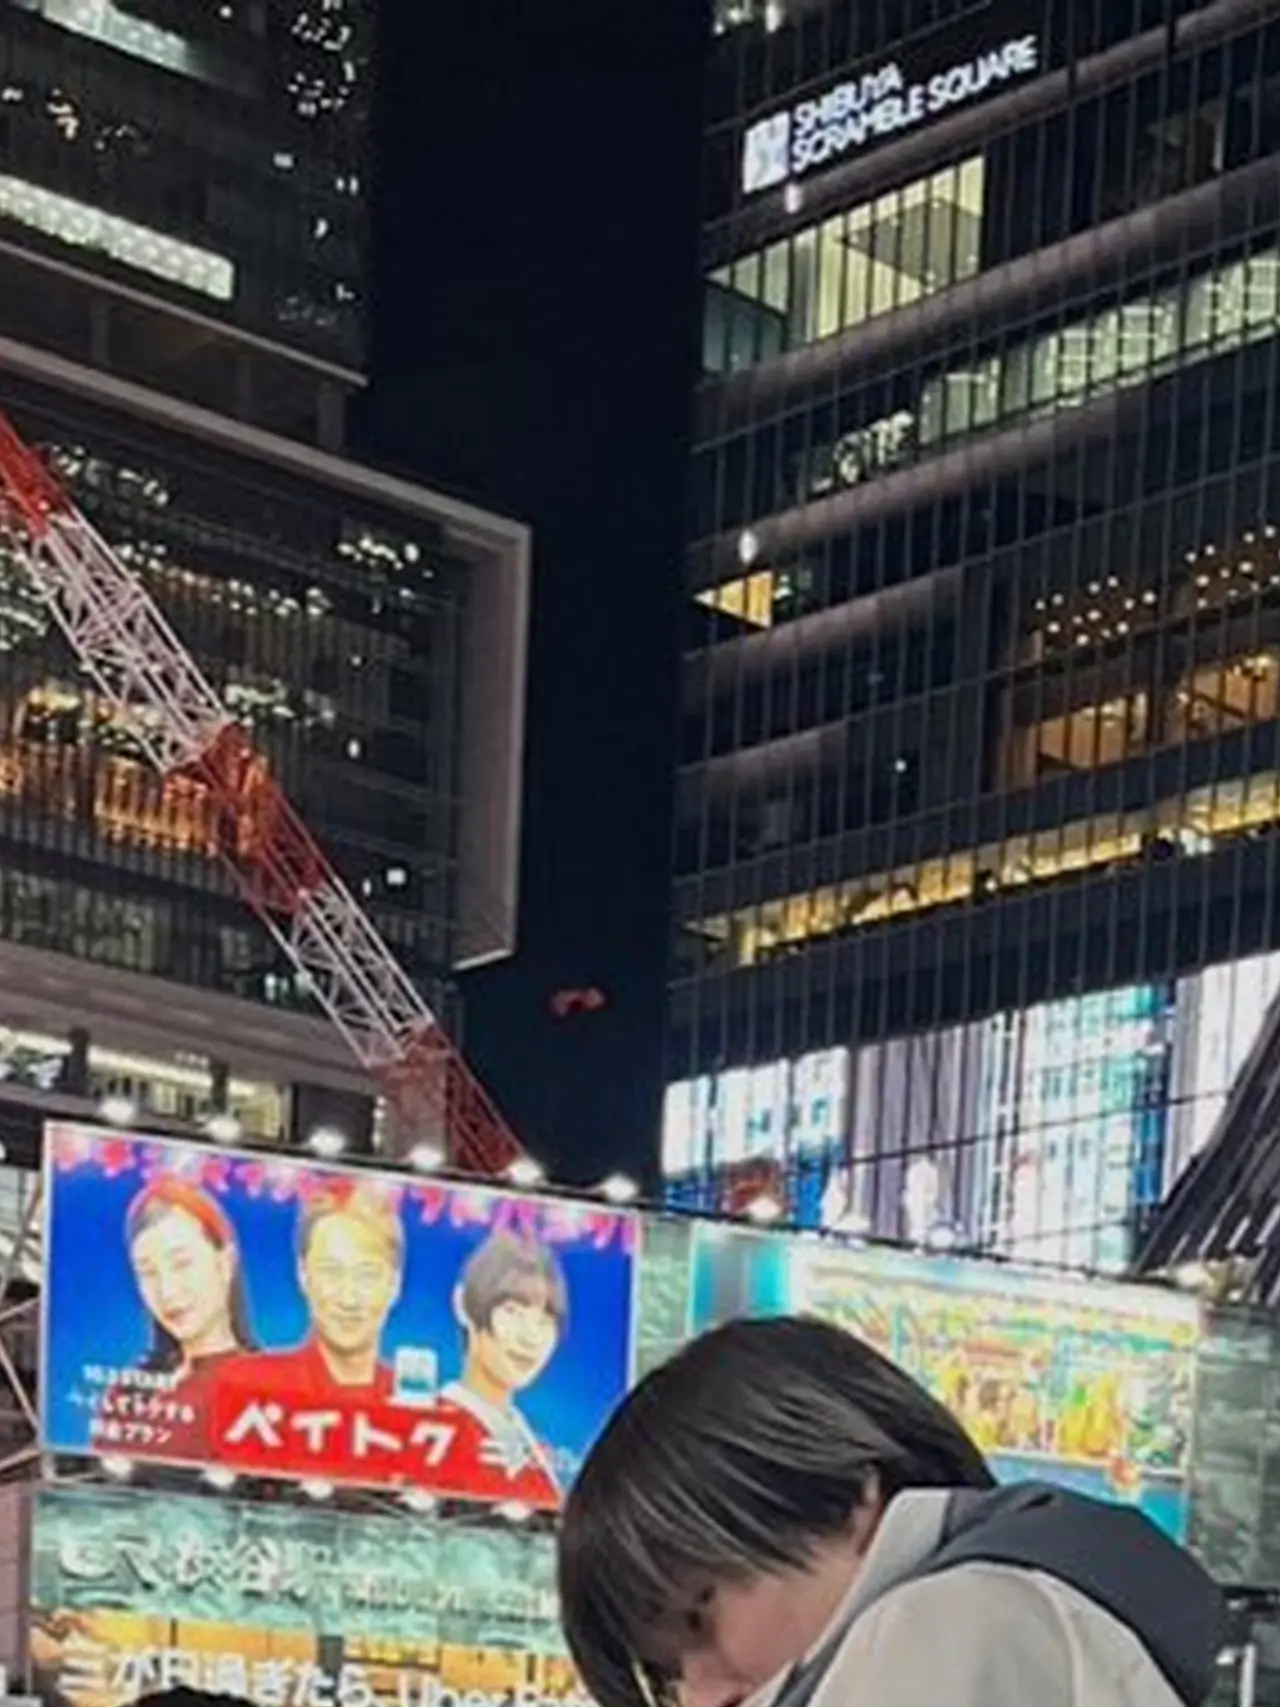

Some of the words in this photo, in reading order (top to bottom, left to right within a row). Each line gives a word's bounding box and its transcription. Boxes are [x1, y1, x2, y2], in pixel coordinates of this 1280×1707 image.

[792, 85, 926, 174] SCRAMBLE
[927, 34, 1038, 112] SQUARE
[793, 61, 903, 140] SHIBUYA
[223, 1398, 457, 1467] ペイトク
